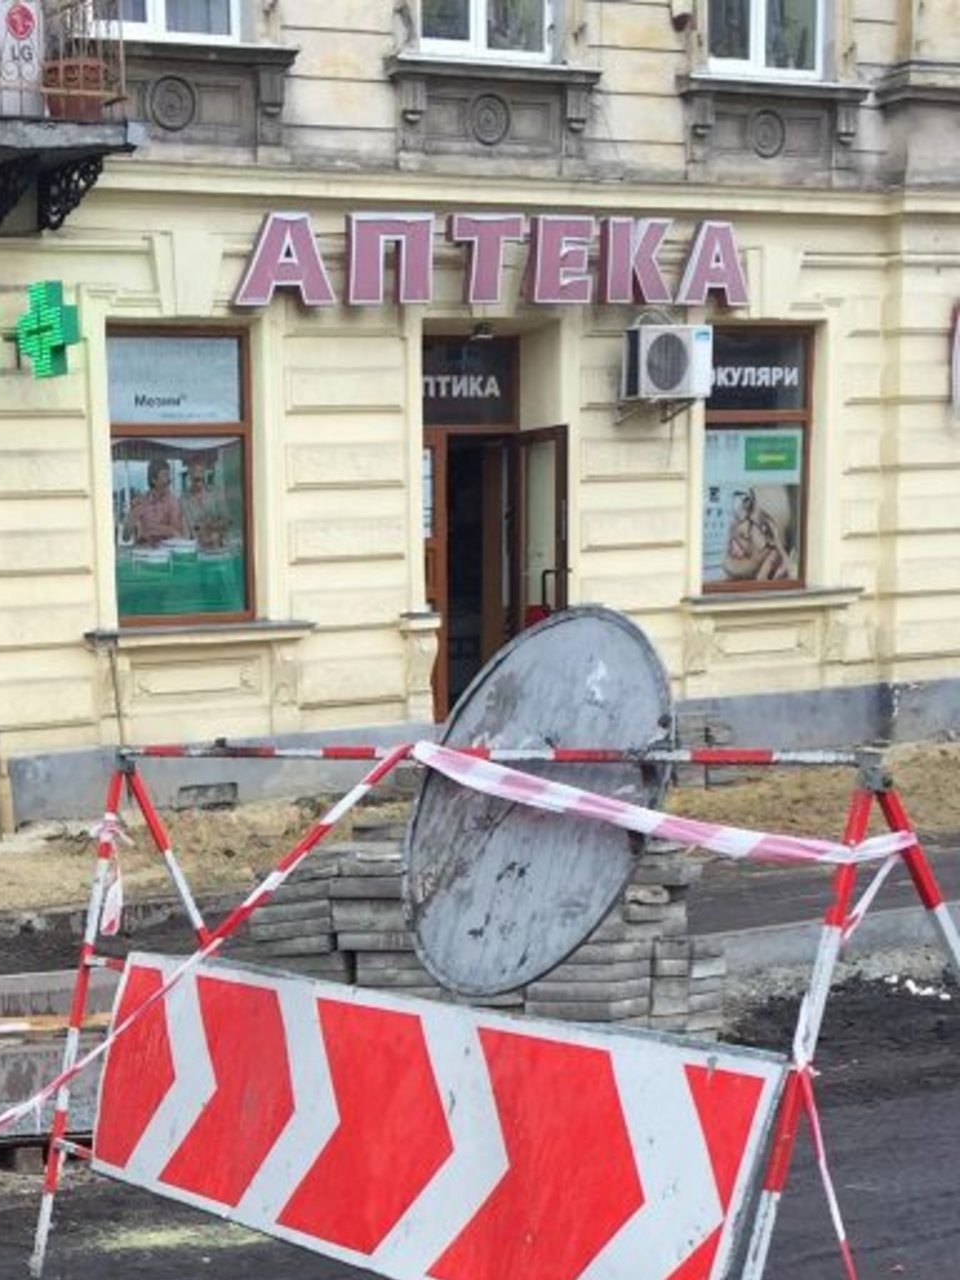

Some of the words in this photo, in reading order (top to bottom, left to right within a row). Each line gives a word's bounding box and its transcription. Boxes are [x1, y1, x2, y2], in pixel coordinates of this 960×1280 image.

[11, 44, 33, 61] LG
[235, 211, 751, 306] АПТЕКА
[423, 375, 501, 398] ПТИКА
